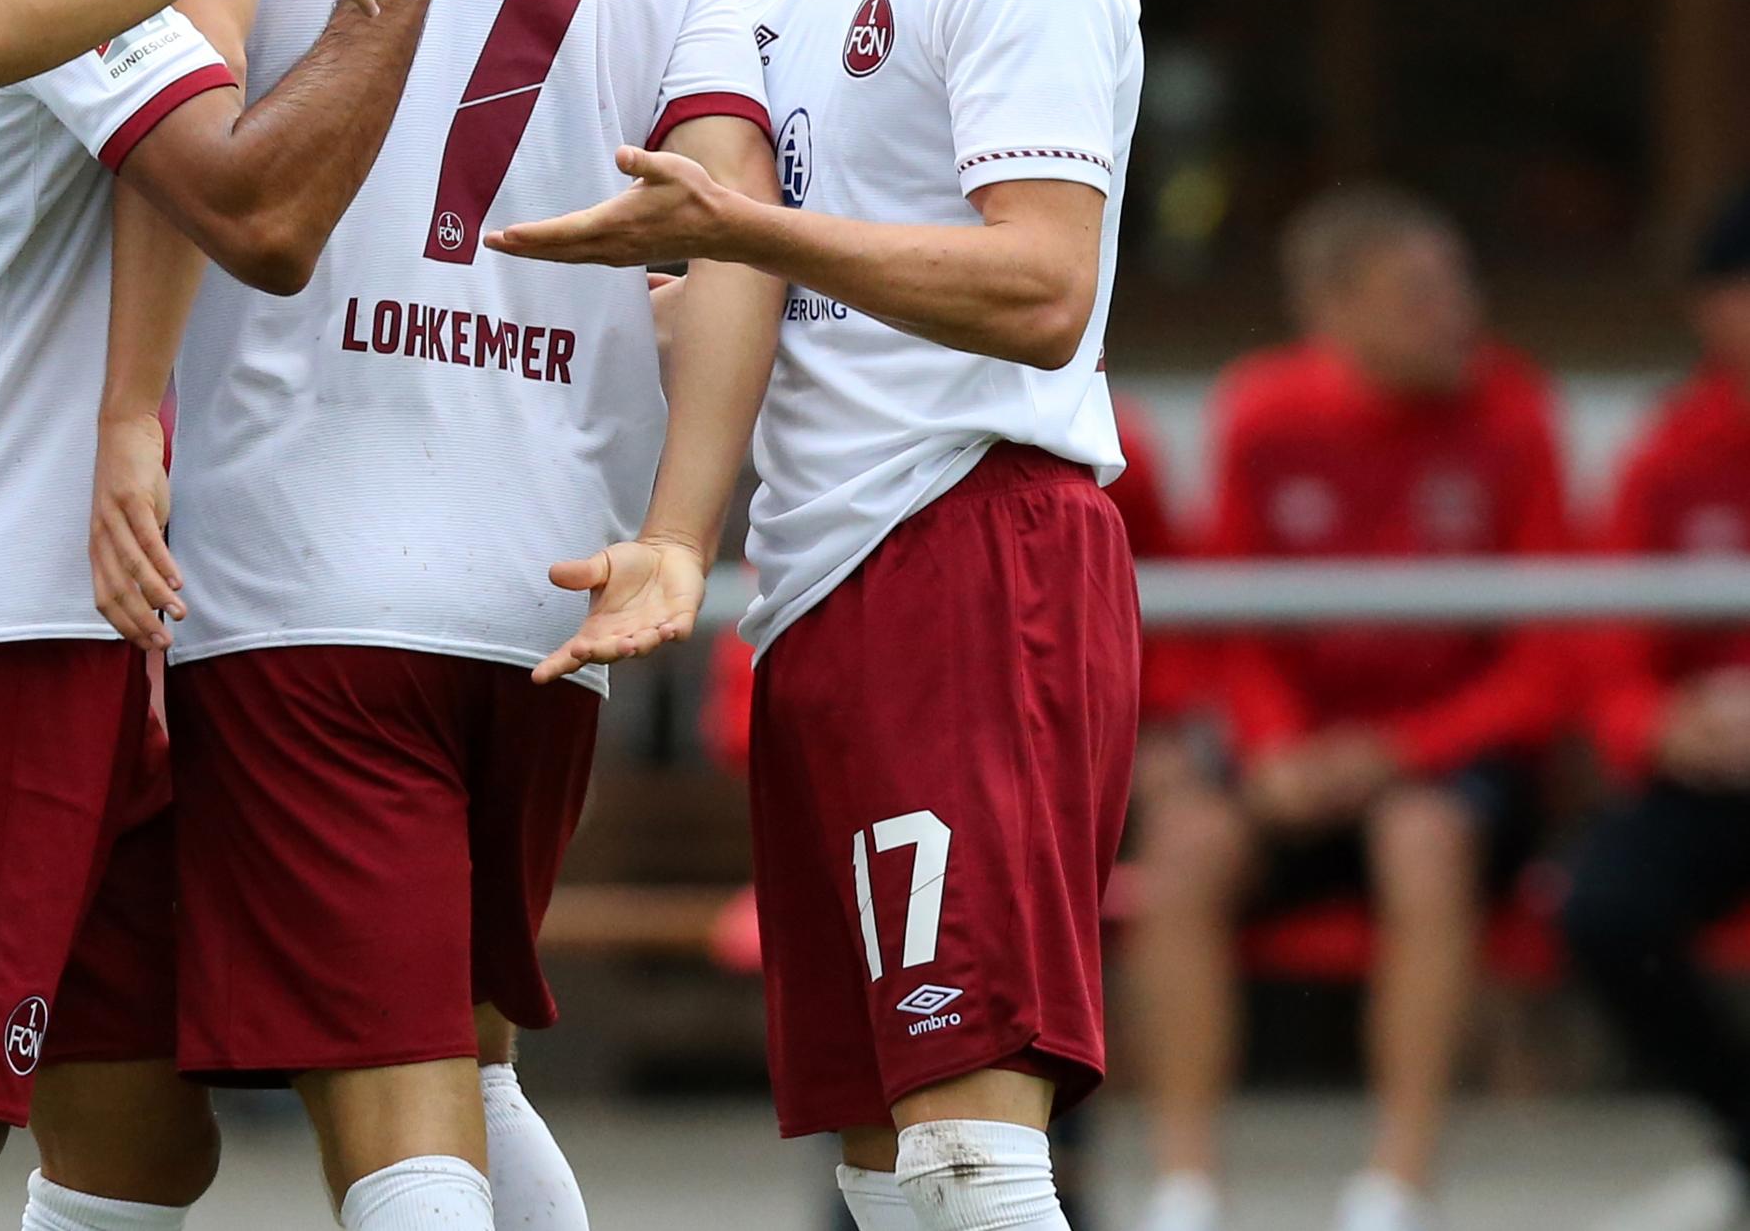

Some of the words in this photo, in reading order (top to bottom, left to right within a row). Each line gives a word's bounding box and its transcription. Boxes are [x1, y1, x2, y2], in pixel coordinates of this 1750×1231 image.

[110, 31, 182, 79] BUNDESLIGA
[846, 25, 887, 58] FCN
[439, 226, 461, 242] FCN
[341, 297, 576, 384] LOHKEMPER
[852, 809, 952, 983] 17
[8, 1024, 43, 1059] FCN
[908, 1012, 961, 1036] umbro
